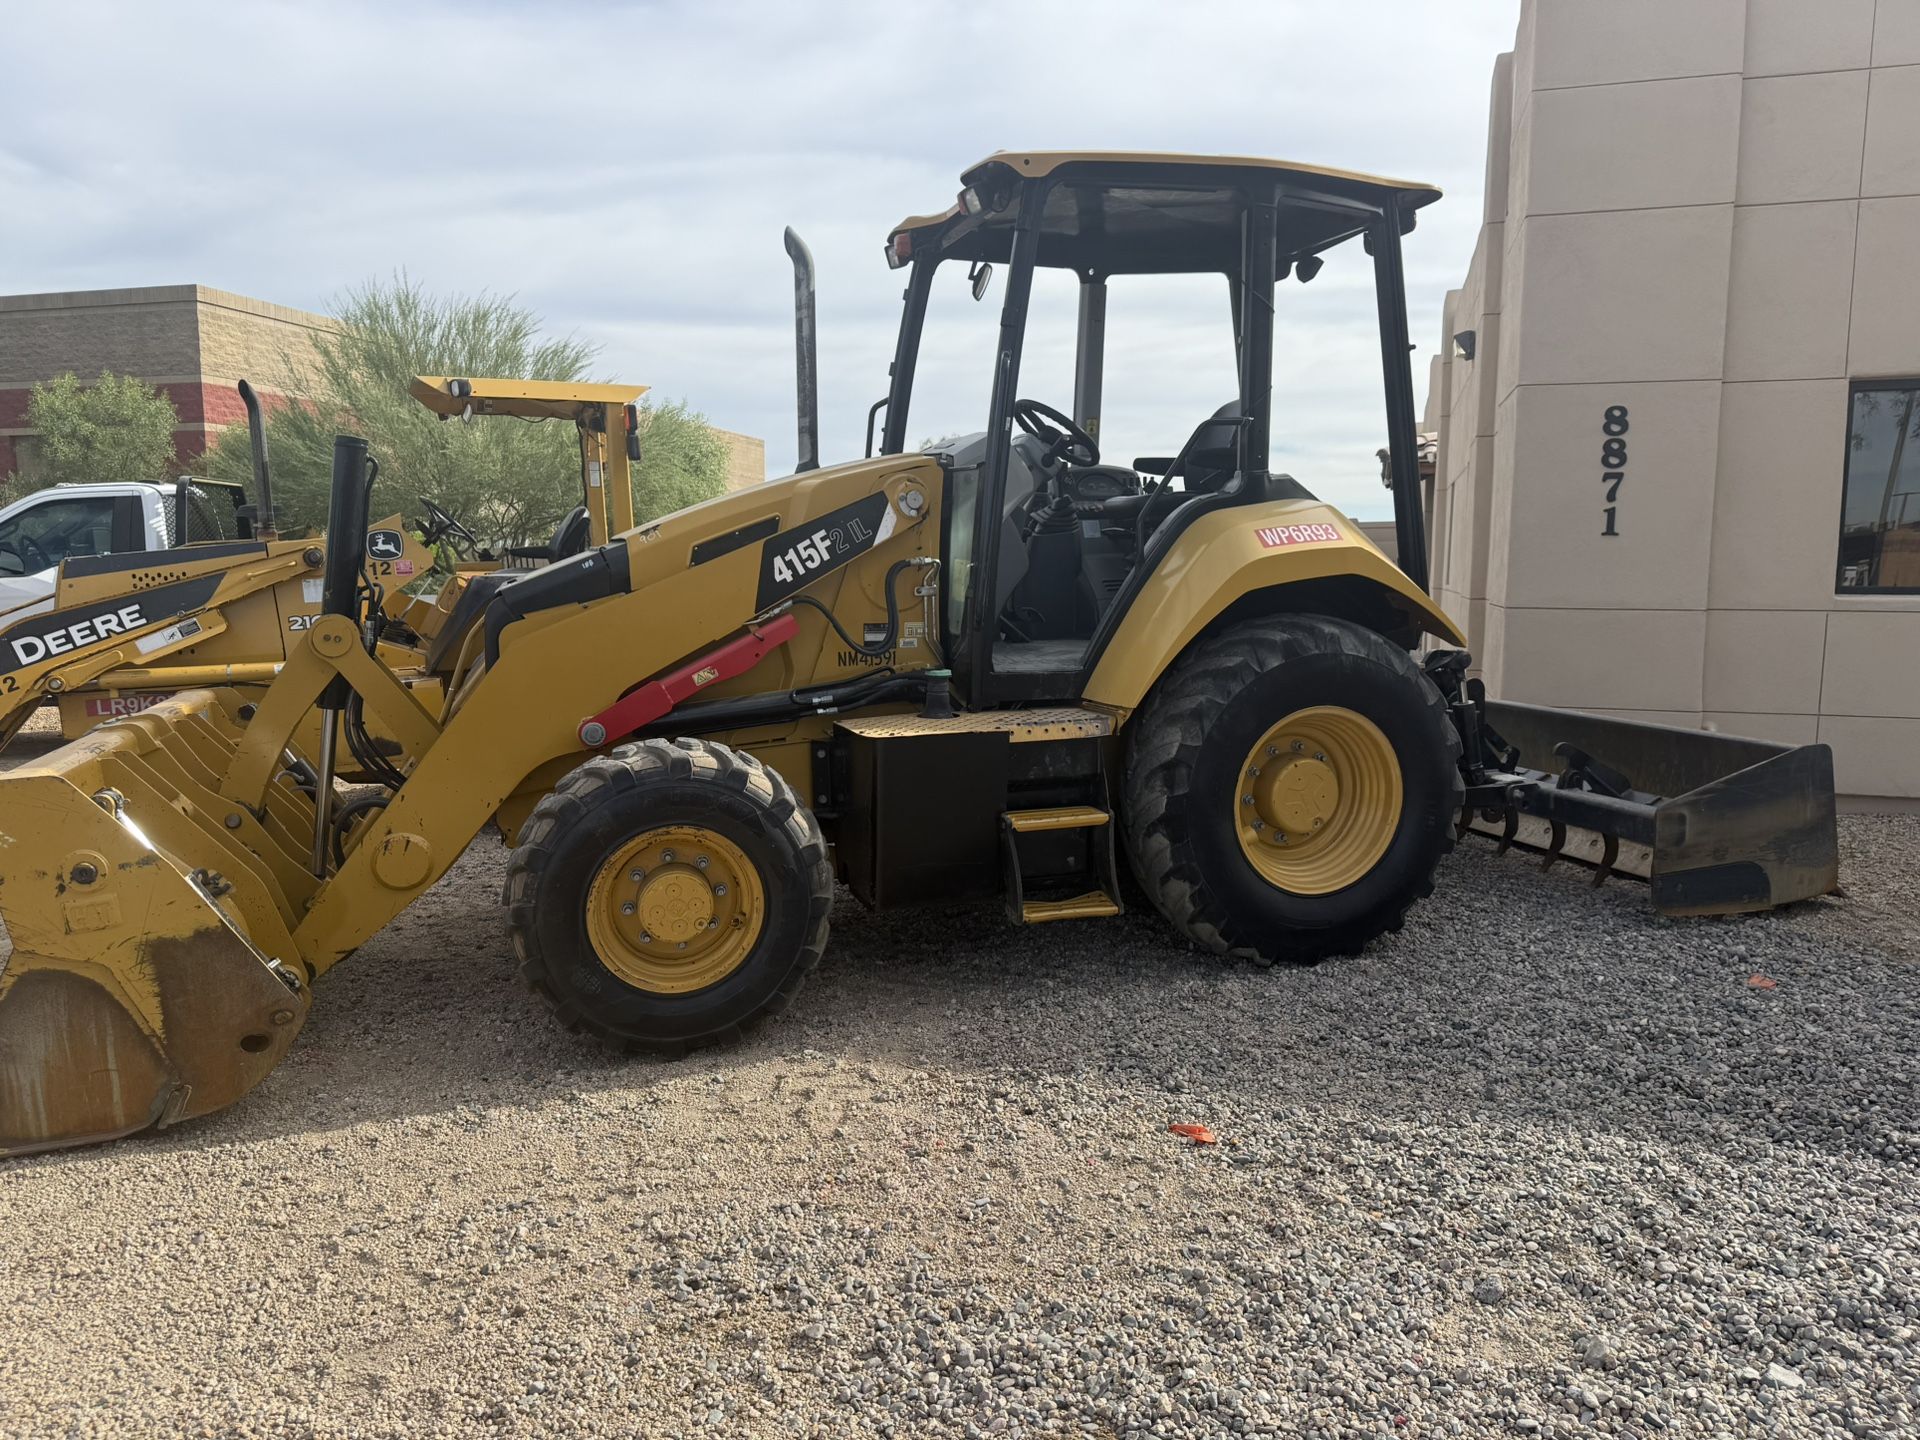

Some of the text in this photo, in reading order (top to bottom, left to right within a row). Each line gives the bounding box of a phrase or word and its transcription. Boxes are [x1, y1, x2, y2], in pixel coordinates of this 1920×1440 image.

[1601, 405, 1629, 536] 8871
[1258, 523, 1338, 546] WP6R93
[11, 603, 147, 665] DEERE
